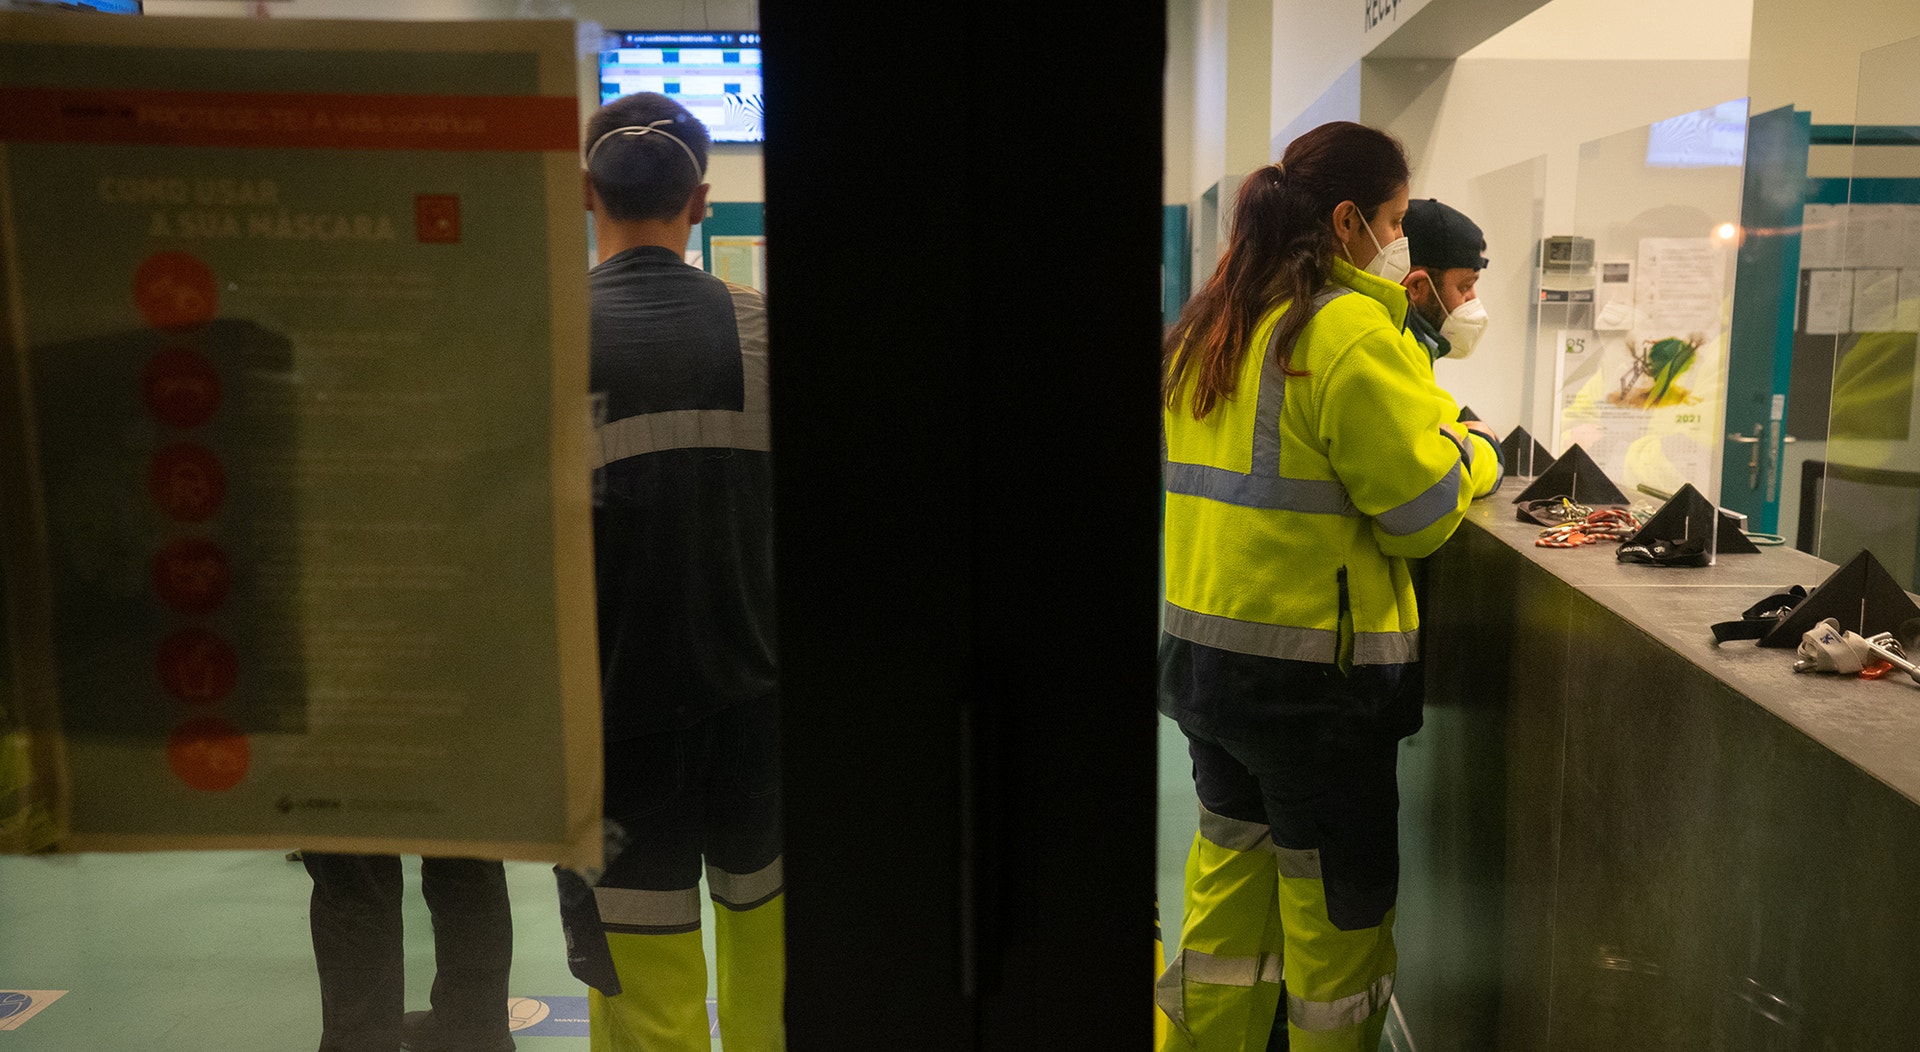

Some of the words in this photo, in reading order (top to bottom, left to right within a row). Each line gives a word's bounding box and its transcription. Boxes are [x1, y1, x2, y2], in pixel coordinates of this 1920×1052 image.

[99, 177, 188, 204] COMO
[194, 179, 280, 206] USAR
[149, 211, 171, 236] A
[178, 211, 241, 238] SUA
[247, 207, 396, 240] MÁSCARA
[1676, 414, 1701, 423] 2021
